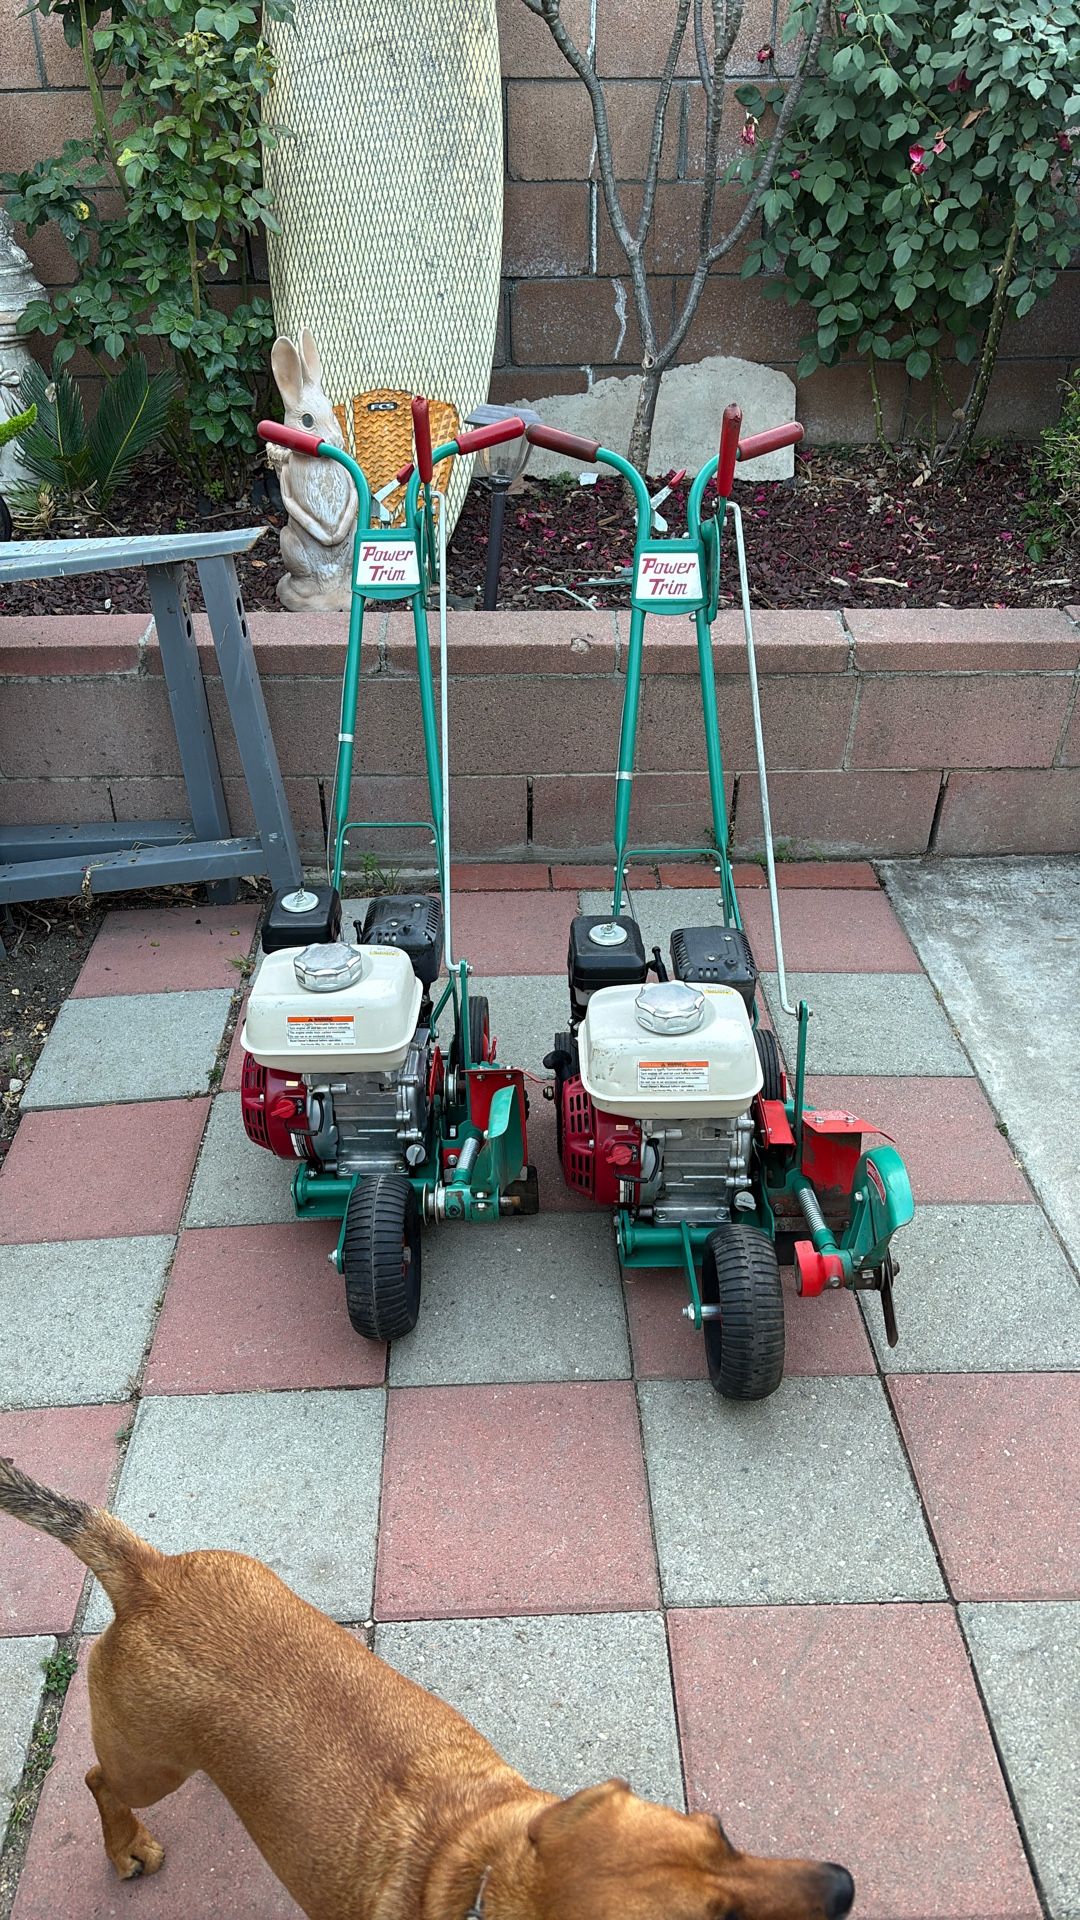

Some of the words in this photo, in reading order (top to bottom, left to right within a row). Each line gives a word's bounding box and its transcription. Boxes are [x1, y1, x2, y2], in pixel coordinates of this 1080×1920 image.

[362, 546, 414, 562] Power
[369, 565, 407, 582] Trim
[641, 557, 697, 575] Power
[648, 578, 688, 596] Trim
